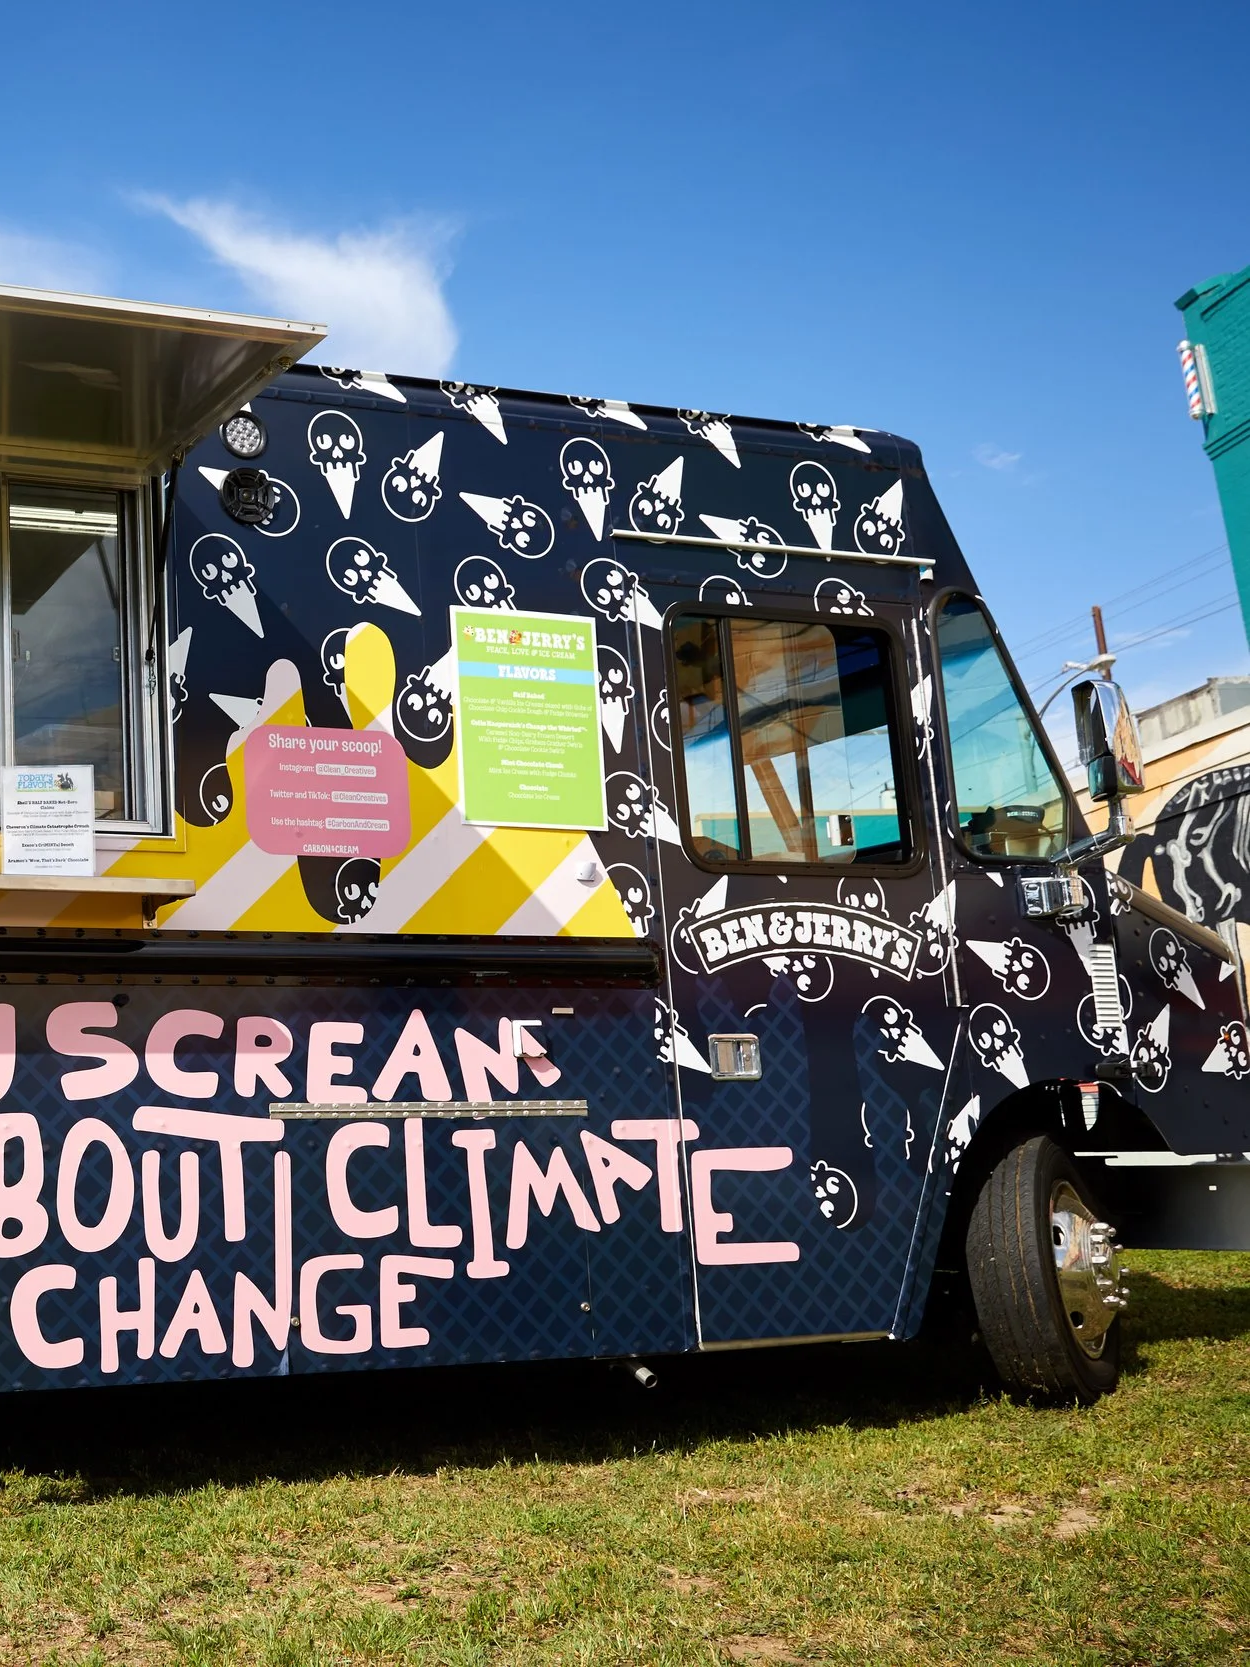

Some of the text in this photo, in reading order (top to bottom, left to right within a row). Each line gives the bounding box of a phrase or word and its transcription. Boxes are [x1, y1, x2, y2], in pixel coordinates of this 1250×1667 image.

[474, 627, 585, 651] BEN JERRY'S
[511, 648, 530, 656] LOVE
[539, 650, 551, 658] ICE
[551, 651, 576, 660] CREAM
[498, 665, 557, 681] FLAVORS
[268, 733, 383, 757] Share your scoop!
[279, 763, 376, 776] Instagram: @Clean_Creatives
[270, 788, 388, 803] Twitter and TikTok: @CleanCreatives
[271, 817, 388, 830] Use the hashtag: #CarbonAndCream
[45, 1001, 561, 1112] SCREAM
[325, 1116, 801, 1279] CLIMATE
[9, 1150, 455, 1374] CHANGE
